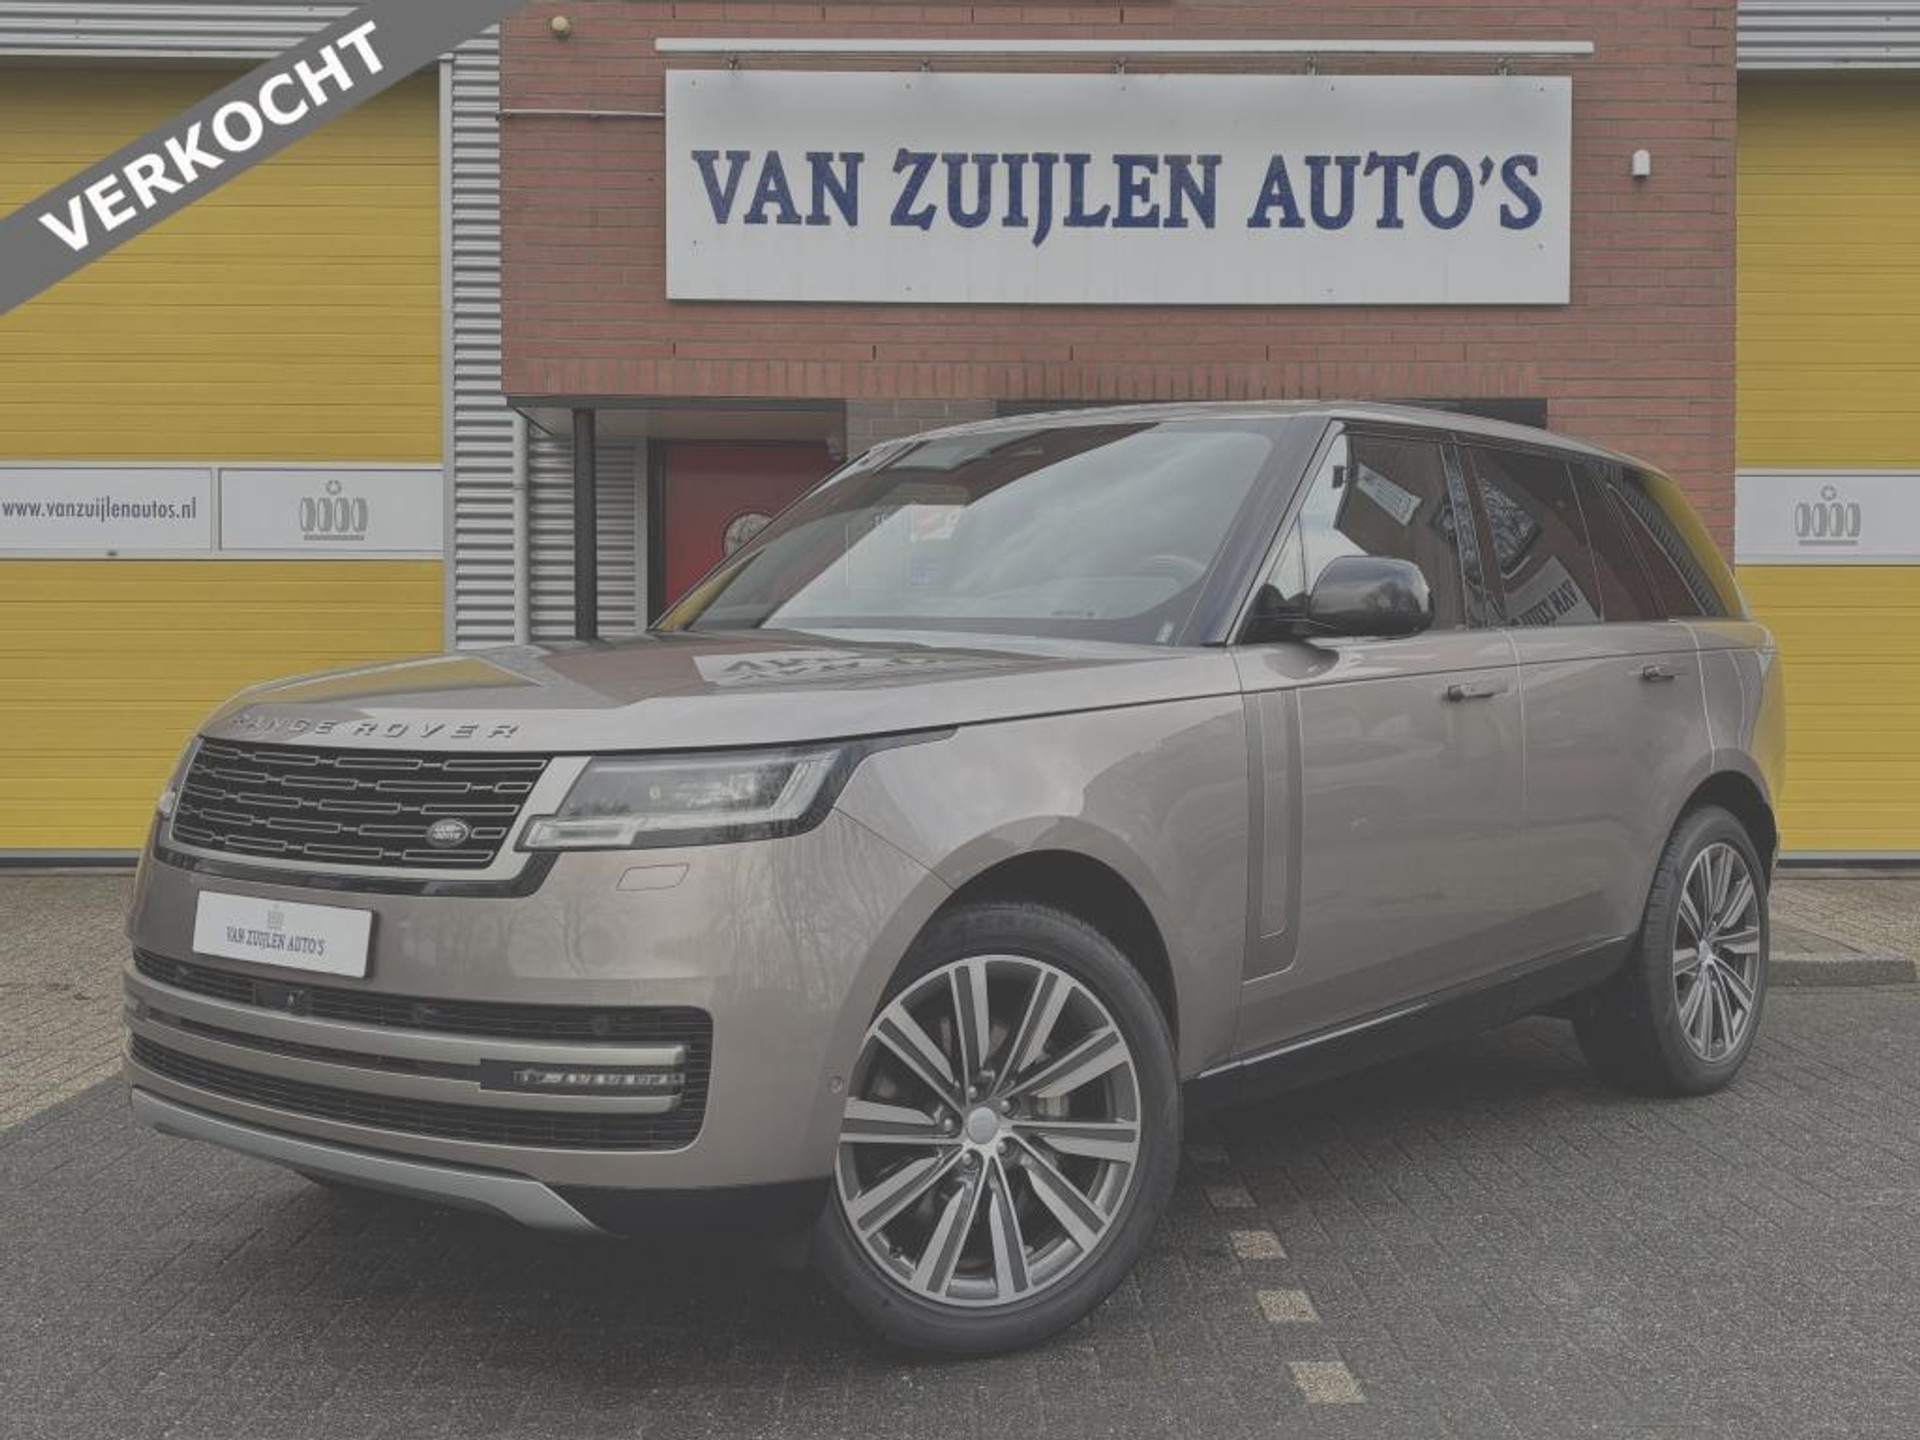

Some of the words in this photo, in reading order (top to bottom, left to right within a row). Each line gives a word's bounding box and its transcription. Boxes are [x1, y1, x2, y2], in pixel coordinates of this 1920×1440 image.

[692, 150, 865, 227] VAN
[891, 148, 1221, 248] ZUIJLEN
[1247, 151, 1543, 231] AUTO'S
[2, 495, 197, 523] www.vanzuijlenautos.nl
[353, 723, 520, 739] ROVER
[226, 926, 245, 944] VAN
[246, 929, 286, 951] ZUIJLEN
[287, 933, 326, 956] AUTO'S
